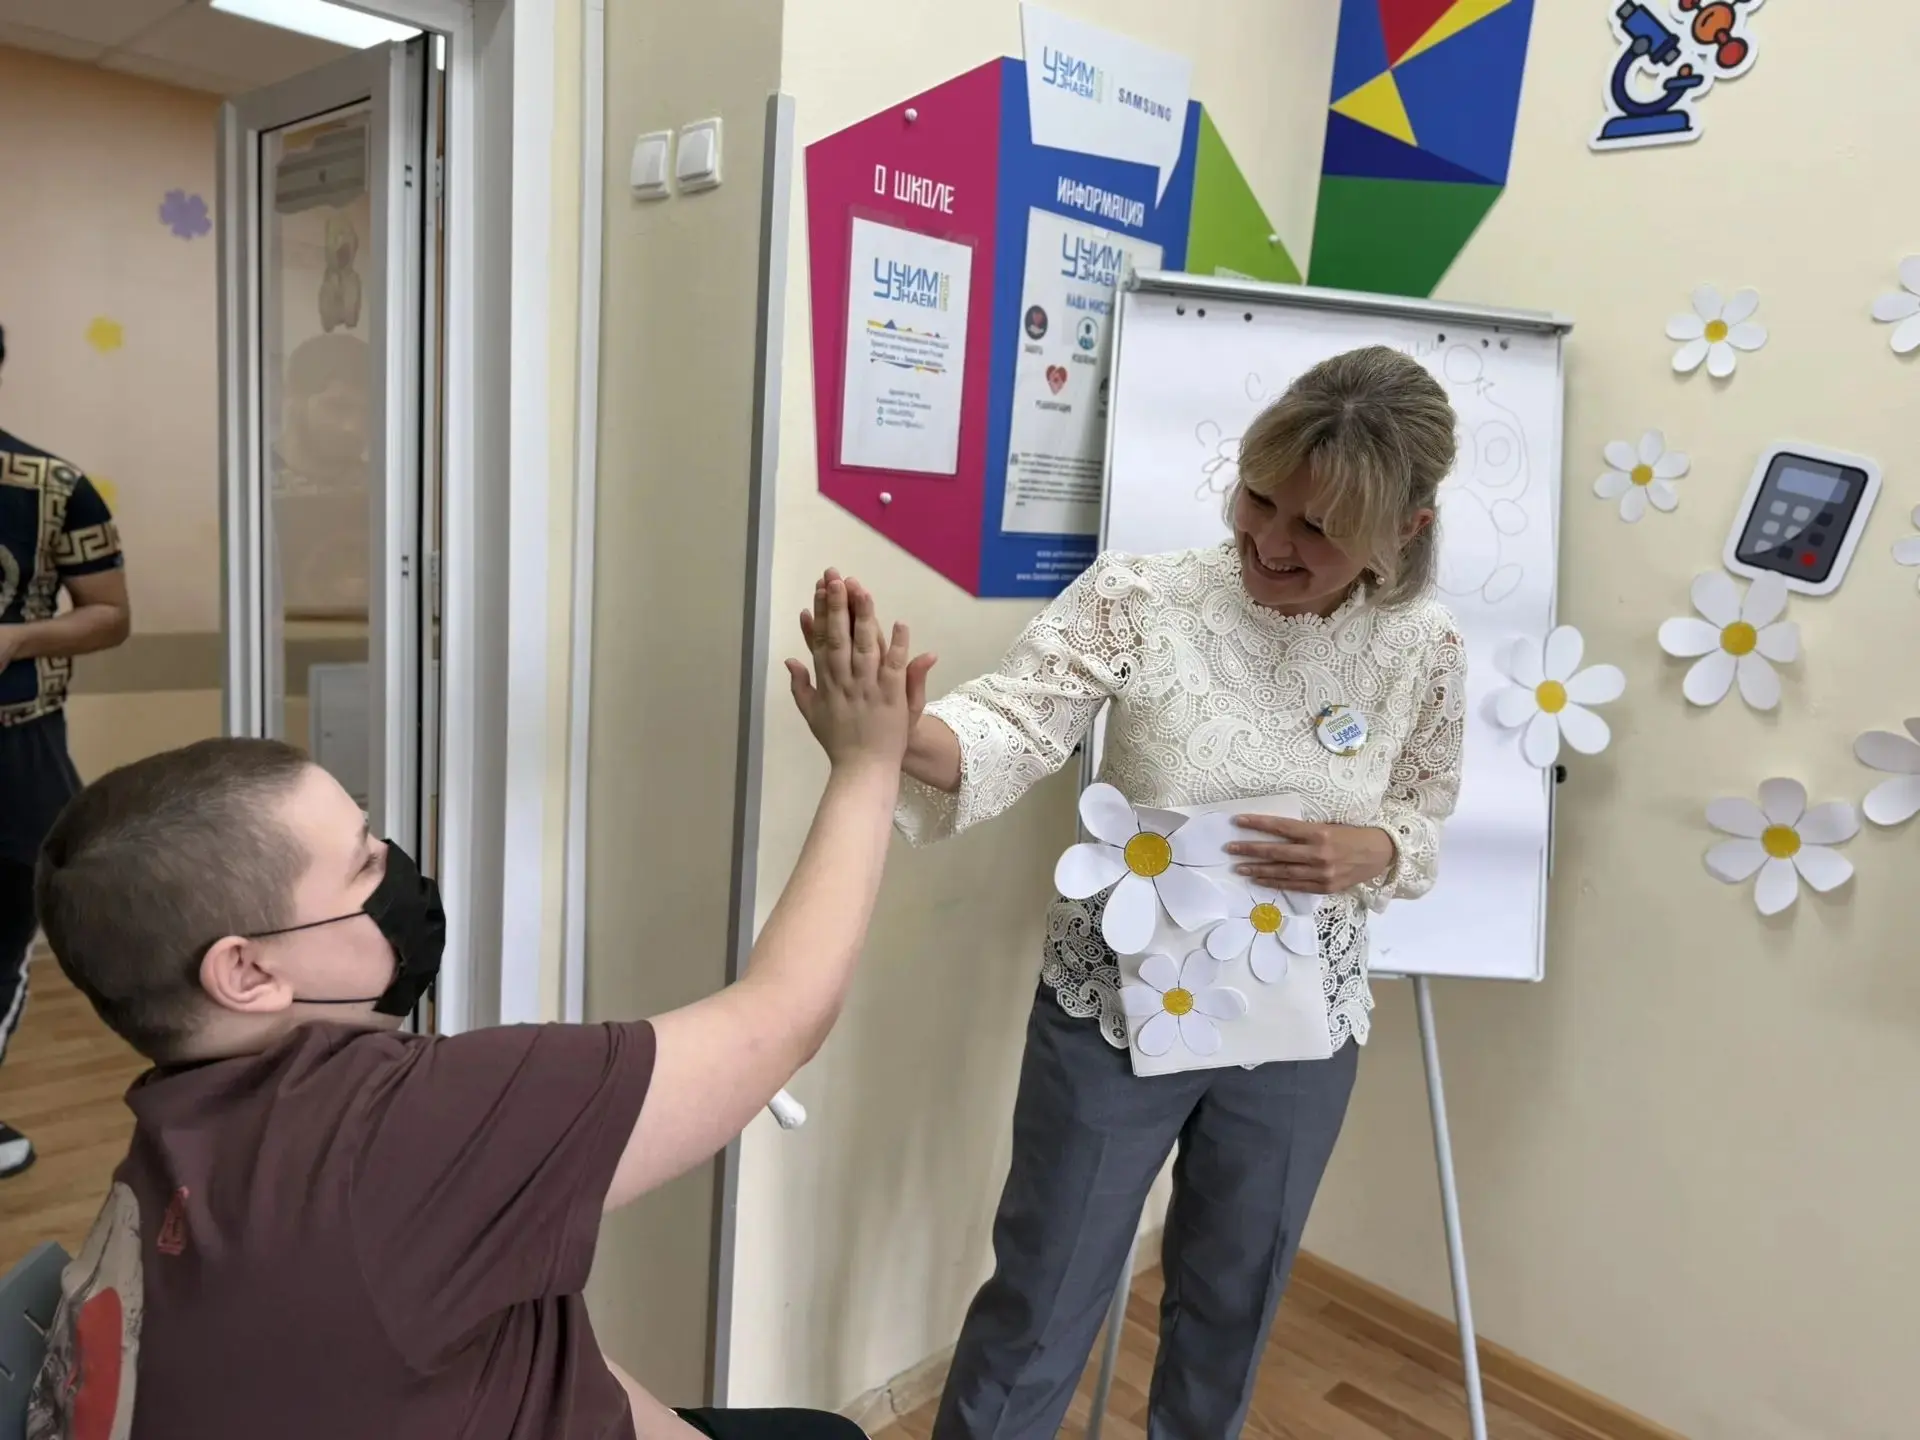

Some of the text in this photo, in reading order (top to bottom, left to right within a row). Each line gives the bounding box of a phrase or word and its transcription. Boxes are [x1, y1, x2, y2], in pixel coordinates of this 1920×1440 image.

[1118, 87, 1172, 122] SAMSUNG
[874, 164, 955, 214] О ШКОЛЕ
[1057, 176, 1144, 228] ИНФОРМАЦИЯ
